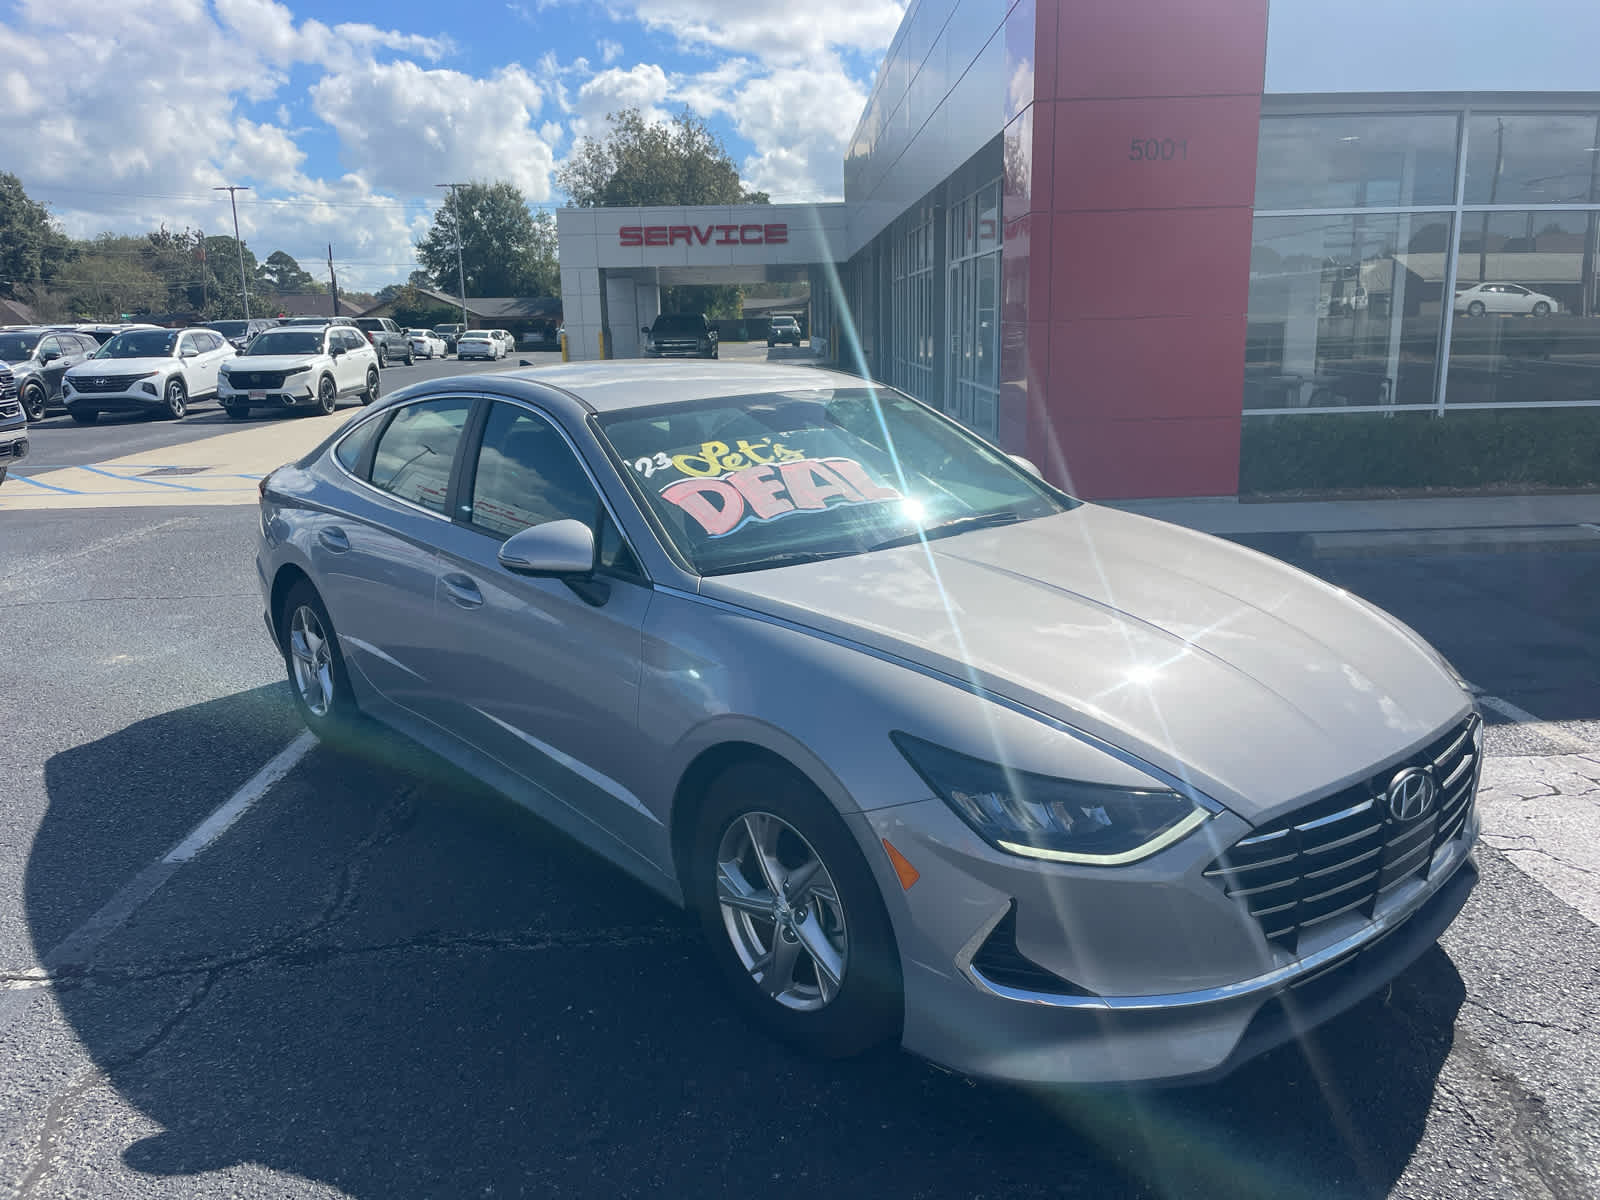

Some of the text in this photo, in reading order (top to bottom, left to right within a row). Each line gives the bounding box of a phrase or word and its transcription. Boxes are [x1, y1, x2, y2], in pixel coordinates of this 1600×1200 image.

[1128, 137, 1189, 161] 5001
[619, 224, 788, 246] SERVICE
[660, 458, 903, 536] DEAL
